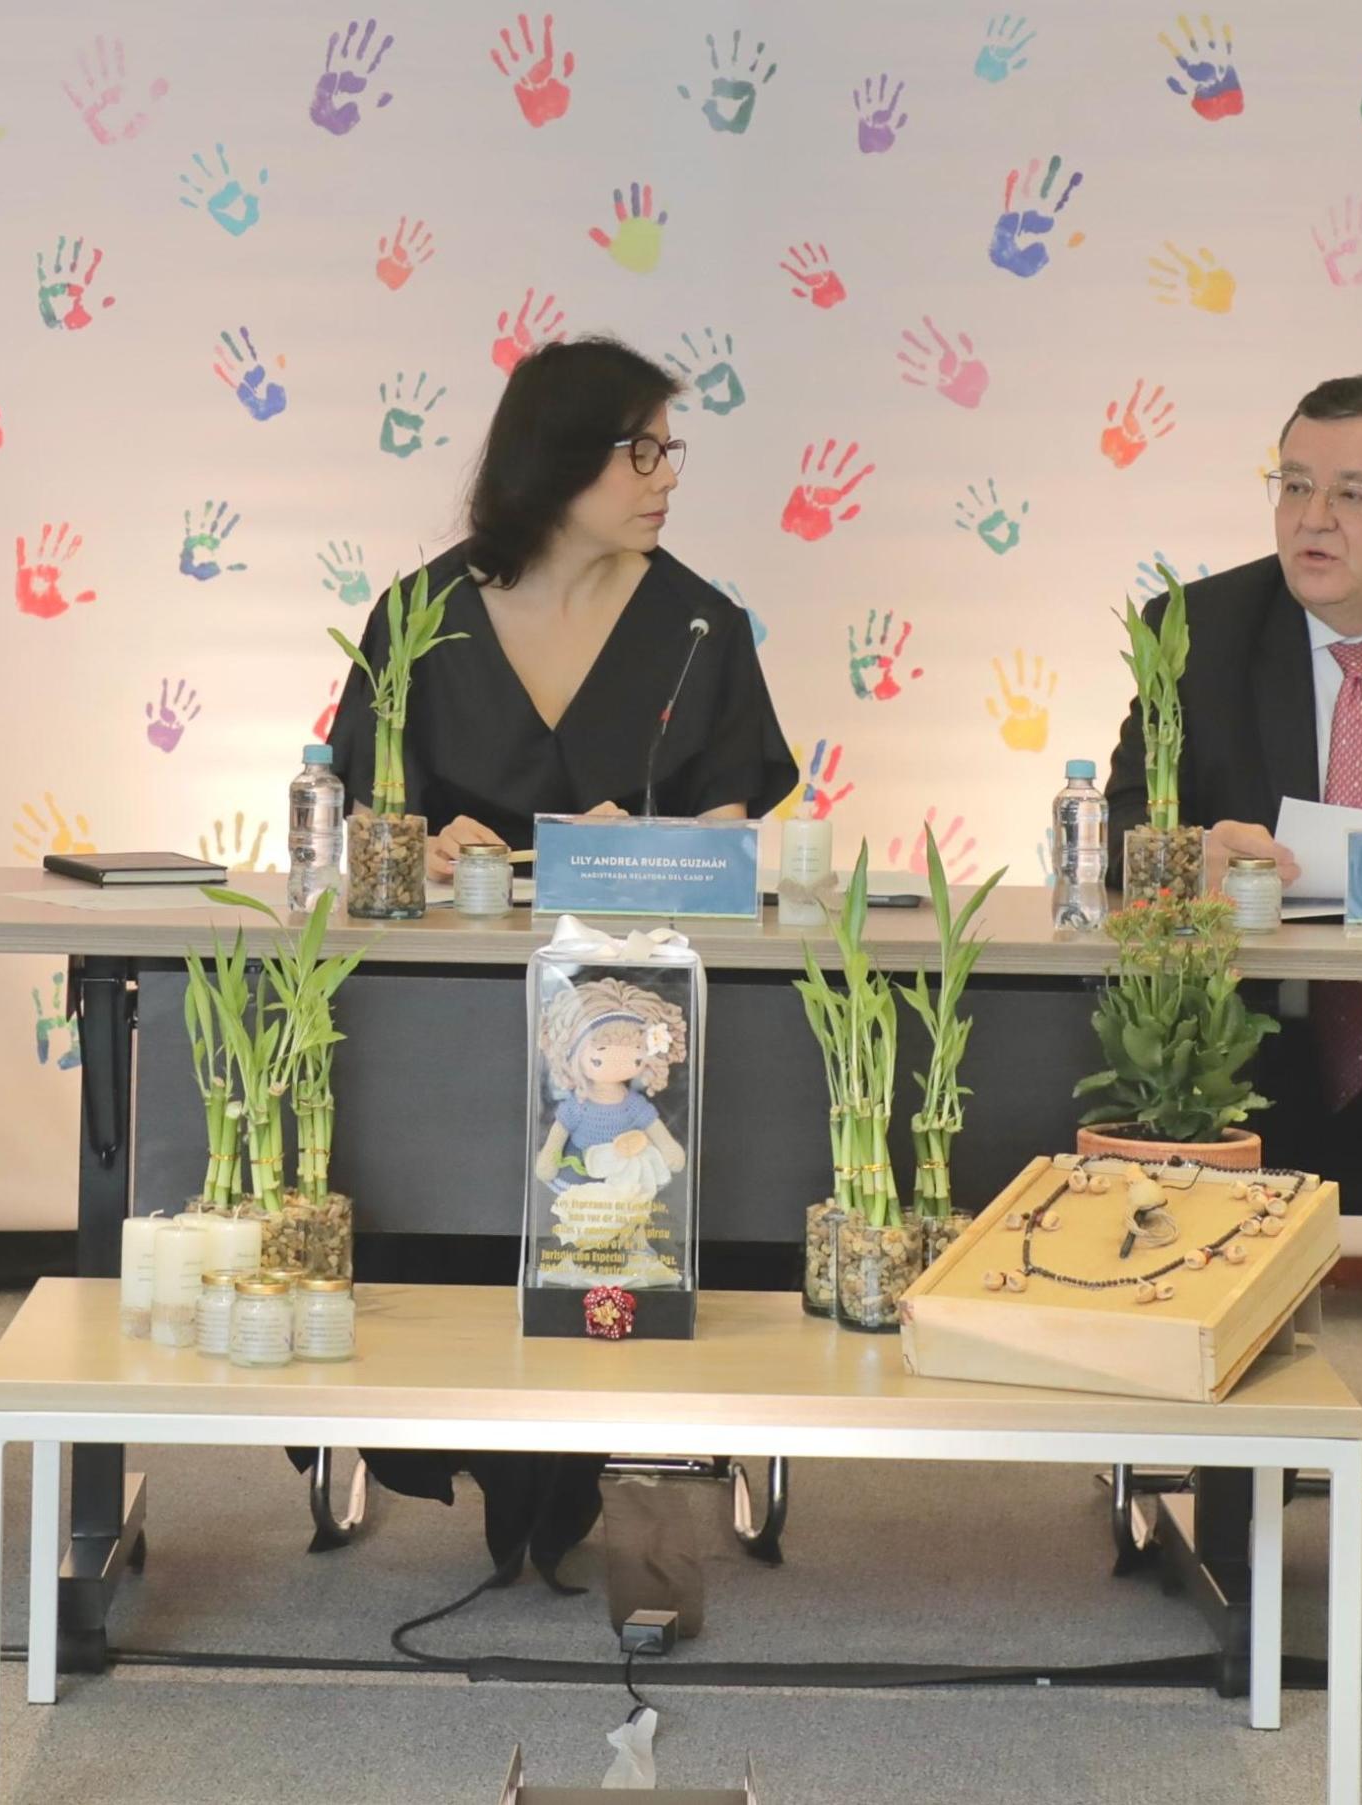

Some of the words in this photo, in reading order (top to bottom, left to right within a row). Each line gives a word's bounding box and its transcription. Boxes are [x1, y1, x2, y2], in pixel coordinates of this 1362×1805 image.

[571, 856, 591, 865] LILY
[593, 857, 638, 866] ANDREA
[641, 858, 677, 867] RUEDA
[680, 857, 727, 868] GUZMÁN
